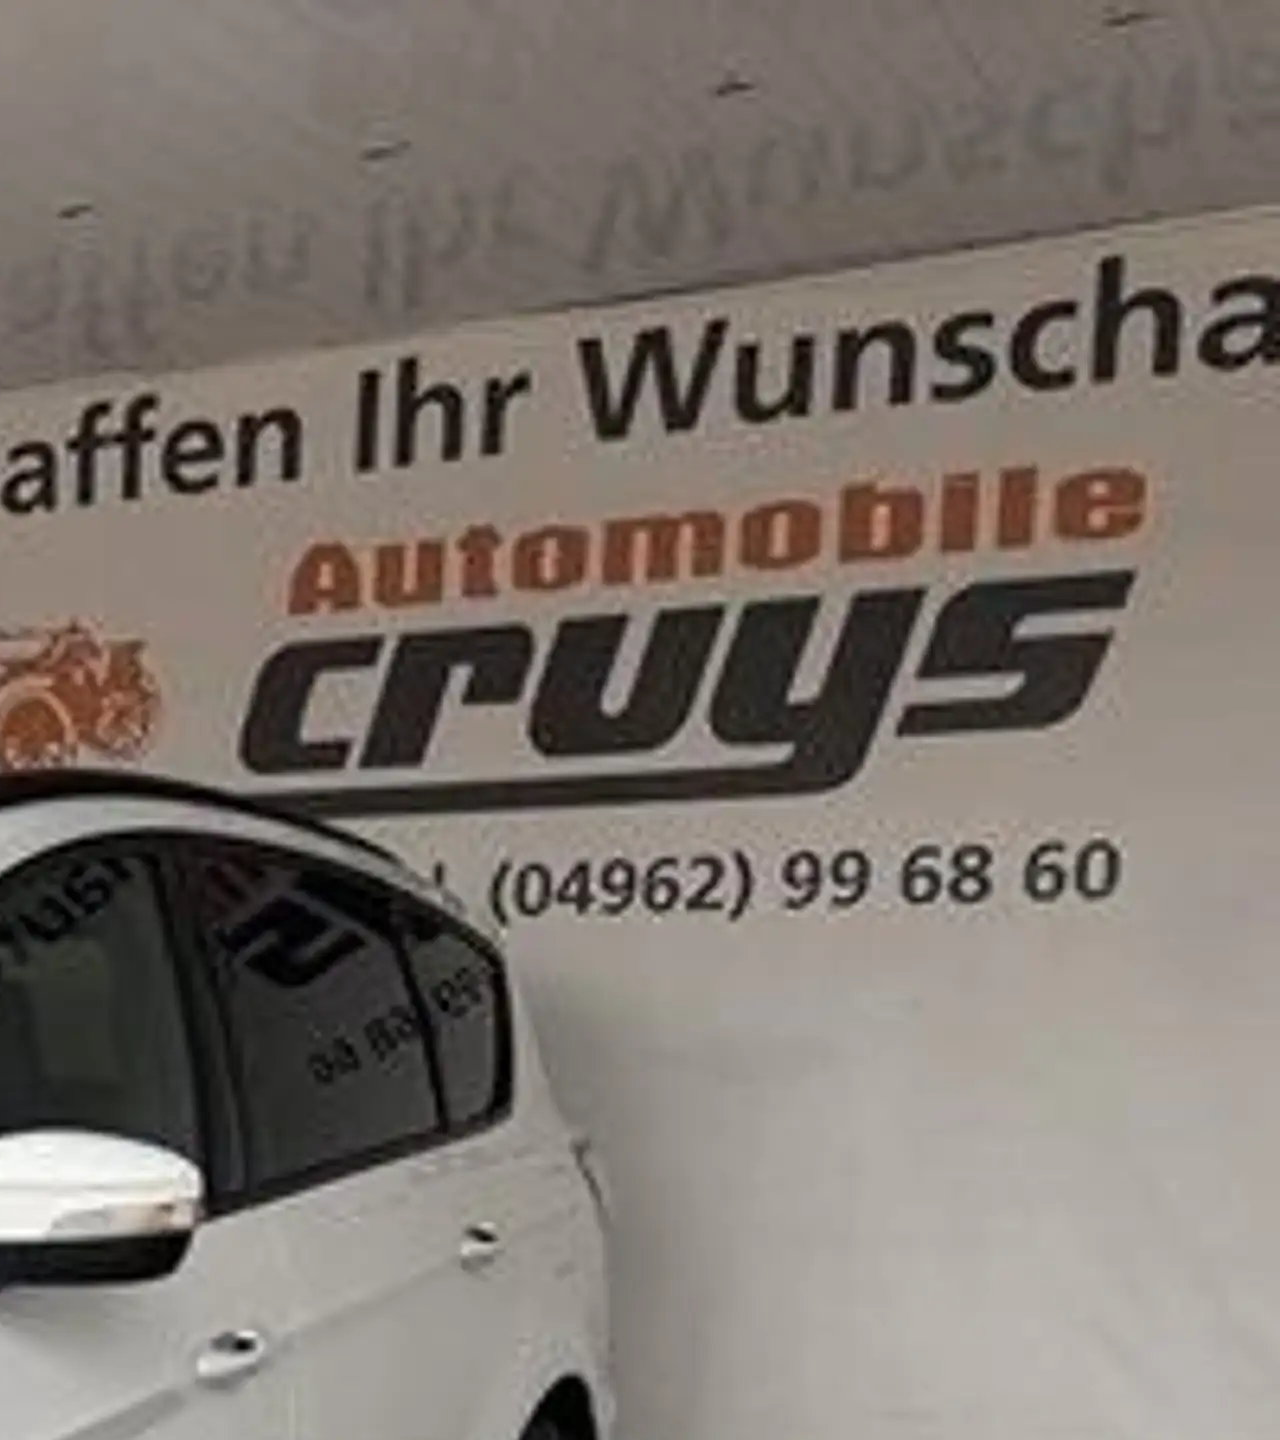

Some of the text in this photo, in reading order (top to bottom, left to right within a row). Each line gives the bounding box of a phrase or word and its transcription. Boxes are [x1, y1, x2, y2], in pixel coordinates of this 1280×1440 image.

[355, 356, 531, 473] Ihr
[576, 255, 1280, 442] Wunscha
[287, 465, 1149, 615] Automobile
[488, 850, 753, 927] (04962)
[782, 849, 872, 910] 99
[901, 844, 994, 905] 68
[1024, 839, 1121, 902] 60
